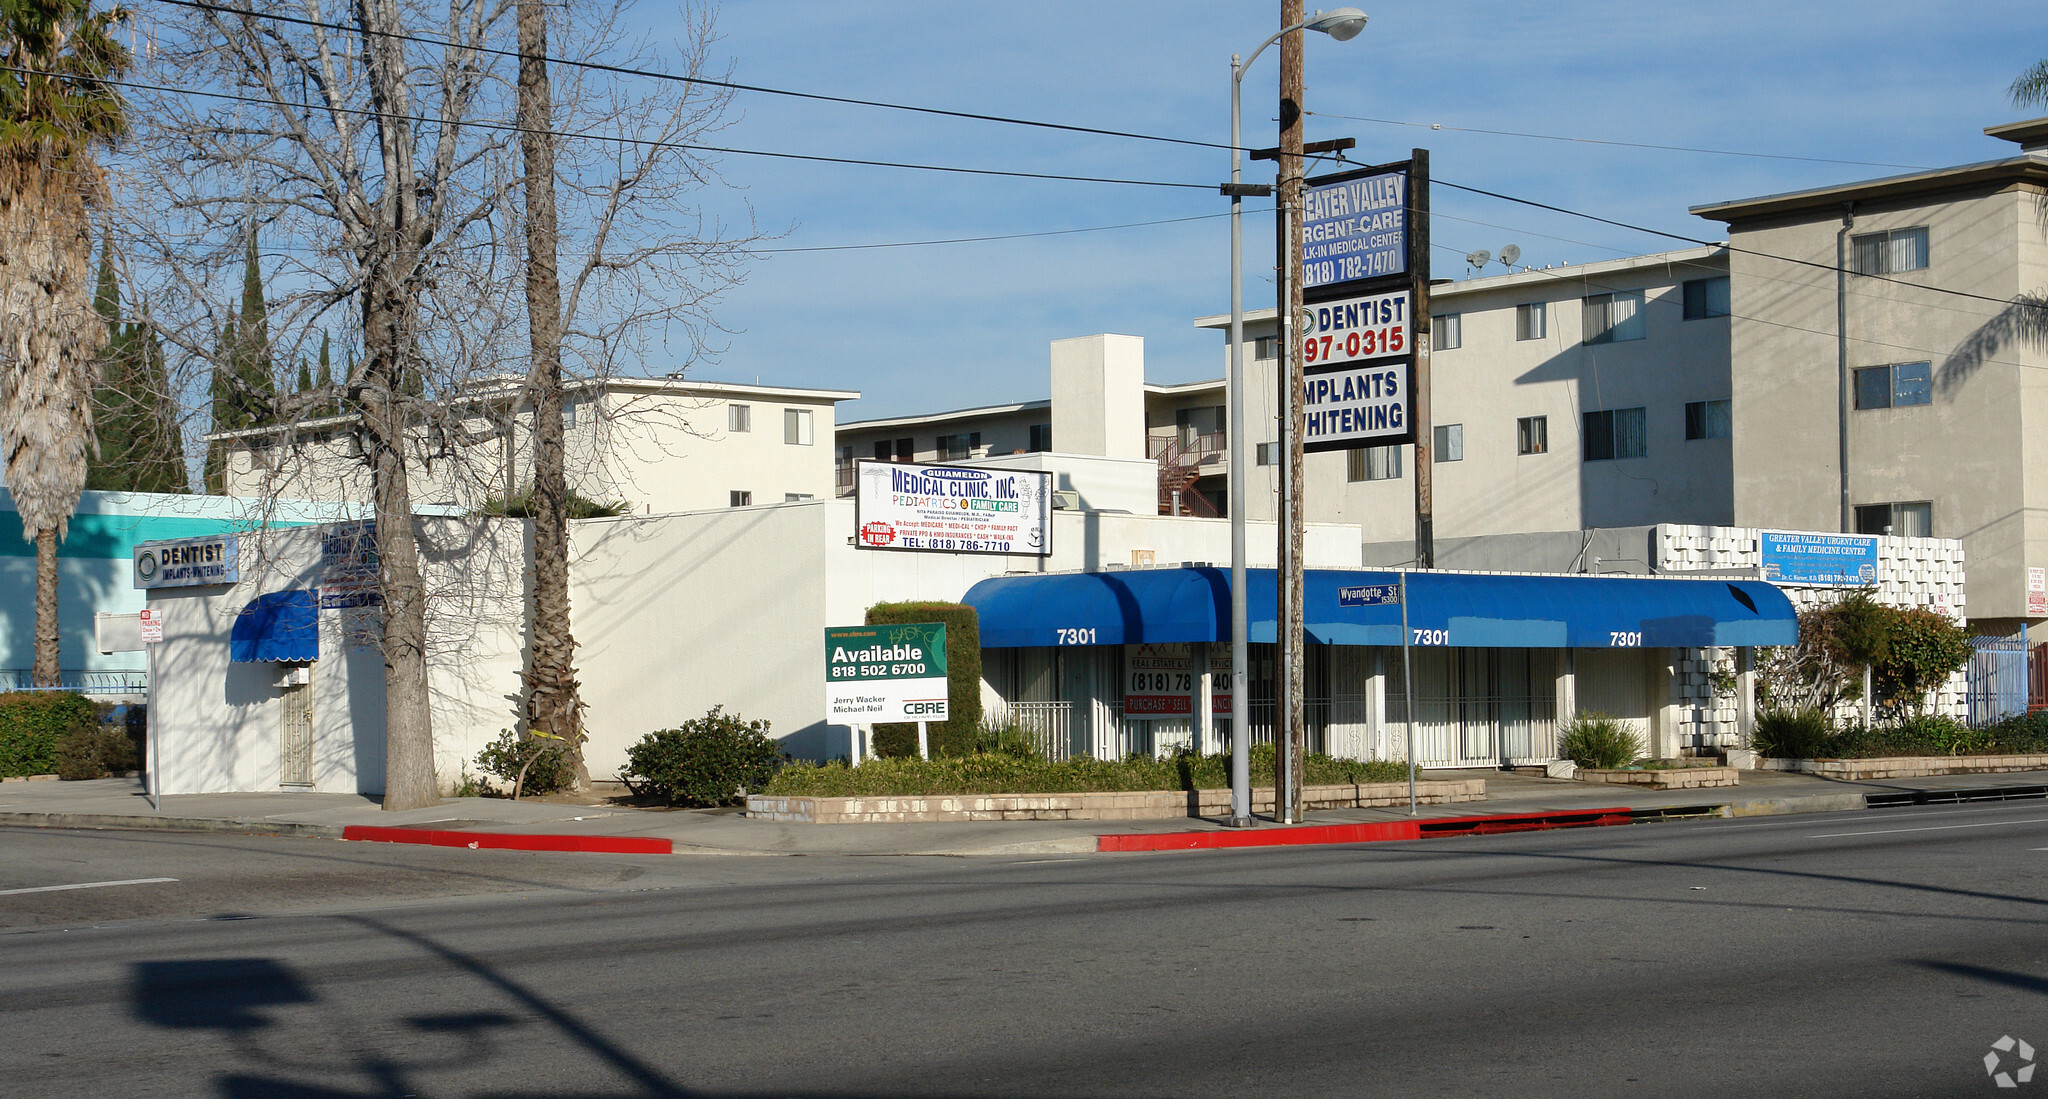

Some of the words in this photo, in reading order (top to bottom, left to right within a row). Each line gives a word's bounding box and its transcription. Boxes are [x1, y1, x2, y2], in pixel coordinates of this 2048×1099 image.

[1302, 186, 1349, 222] EATER
[1350, 175, 1403, 213] VALLEY
[1302, 219, 1355, 244] RGENT
[1360, 209, 1403, 233] CARE
[1329, 237, 1369, 255] MEDICAL
[1370, 231, 1403, 248] CENTER
[1338, 249, 1396, 280] 782-7470
[1319, 296, 1406, 332] DENTIST
[1303, 371, 1398, 405] MPLANTS
[1303, 402, 1403, 436] HITENING
[926, 470, 988, 479] GUIAMELON
[892, 467, 946, 496] MEDICAL
[950, 481, 992, 499] CLINIC,
[996, 476, 1019, 499] INC.
[893, 495, 957, 509] PEDIATRICS
[961, 500, 968, 509] &
[972, 500, 997, 511] FAMILY
[998, 502, 1018, 512] CARE
[866, 523, 891, 534] PARKING
[867, 534, 875, 543] IN
[875, 534, 890, 544] REAR
[902, 537, 924, 548] TEL:
[928, 538, 956, 550] (818)
[960, 540, 1010, 551] 786-7710
[1769, 534, 1800, 543] GREATER
[1801, 535, 1826, 545] VALLEY
[1827, 537, 1853, 546] URGENT
[1853, 538, 1871, 547] CARE
[161, 544, 224, 565] DENTIST
[1775, 544, 1781, 553] &
[1782, 545, 1807, 553] FAMILY
[1807, 546, 1841, 555] MEDICINE
[1841, 547, 1867, 556] CENTER
[1341, 588, 1382, 601] Wyandotte
[1388, 586, 1397, 596] St
[1381, 596, 1398, 604] 15300
[1057, 628, 1096, 645] 7301
[1413, 629, 1449, 645] 7301
[1610, 631, 1642, 647] 7301
[831, 643, 922, 663] Available
[832, 666, 856, 677] 818
[860, 664, 887, 676] 502
[891, 663, 926, 675] 6700
[1132, 672, 1170, 692] (818)
[833, 697, 854, 705] Jerry
[833, 705, 865, 713] Michael
[903, 702, 945, 714] CBRE
[1130, 698, 1166, 710] PURCHASE
[1173, 698, 1187, 711] SELL
